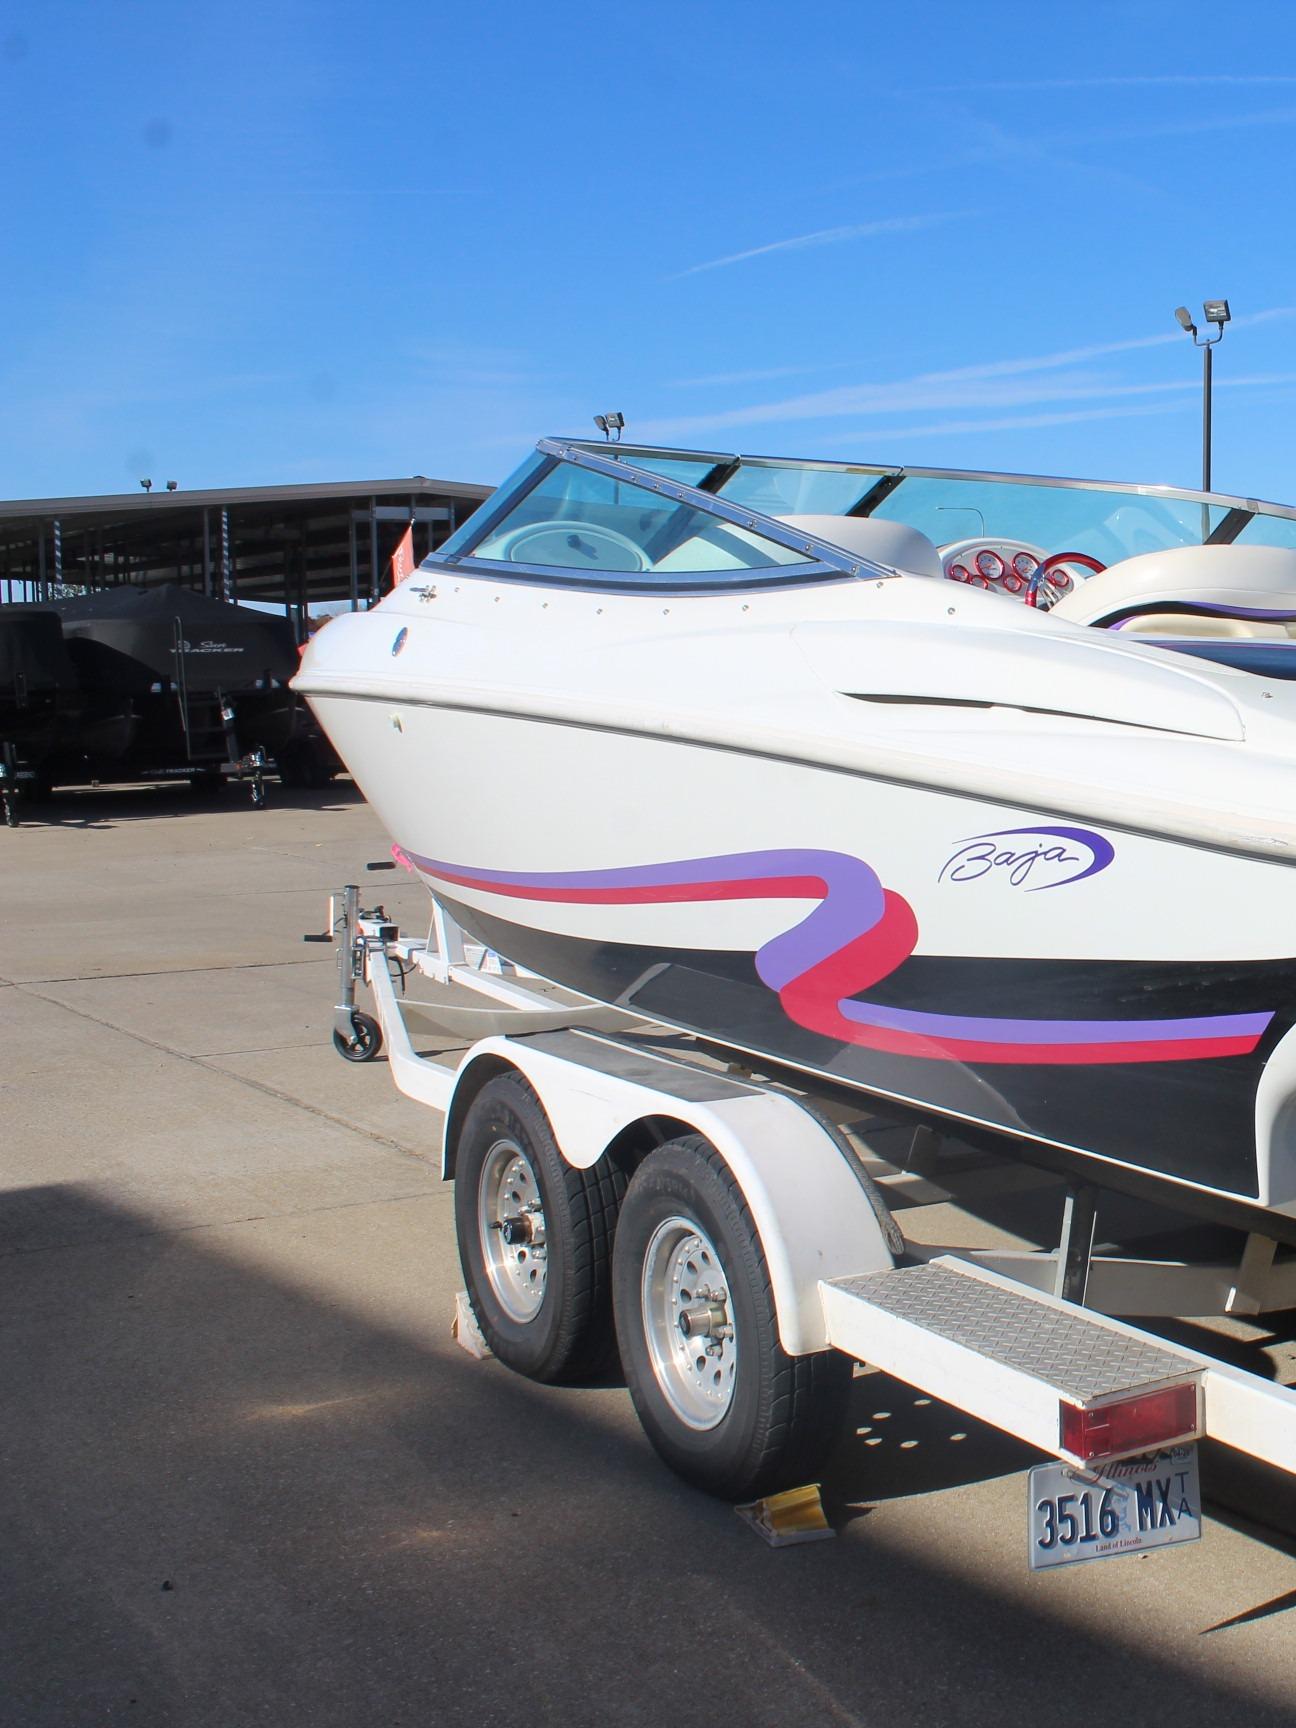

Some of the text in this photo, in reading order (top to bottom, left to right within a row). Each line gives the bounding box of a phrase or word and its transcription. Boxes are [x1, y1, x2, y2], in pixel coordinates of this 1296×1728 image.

[938, 842, 1080, 887] Baja
[1036, 1477, 1177, 1549] 3516 MX
[1095, 1537, 1143, 1553] Land of Lincoln
